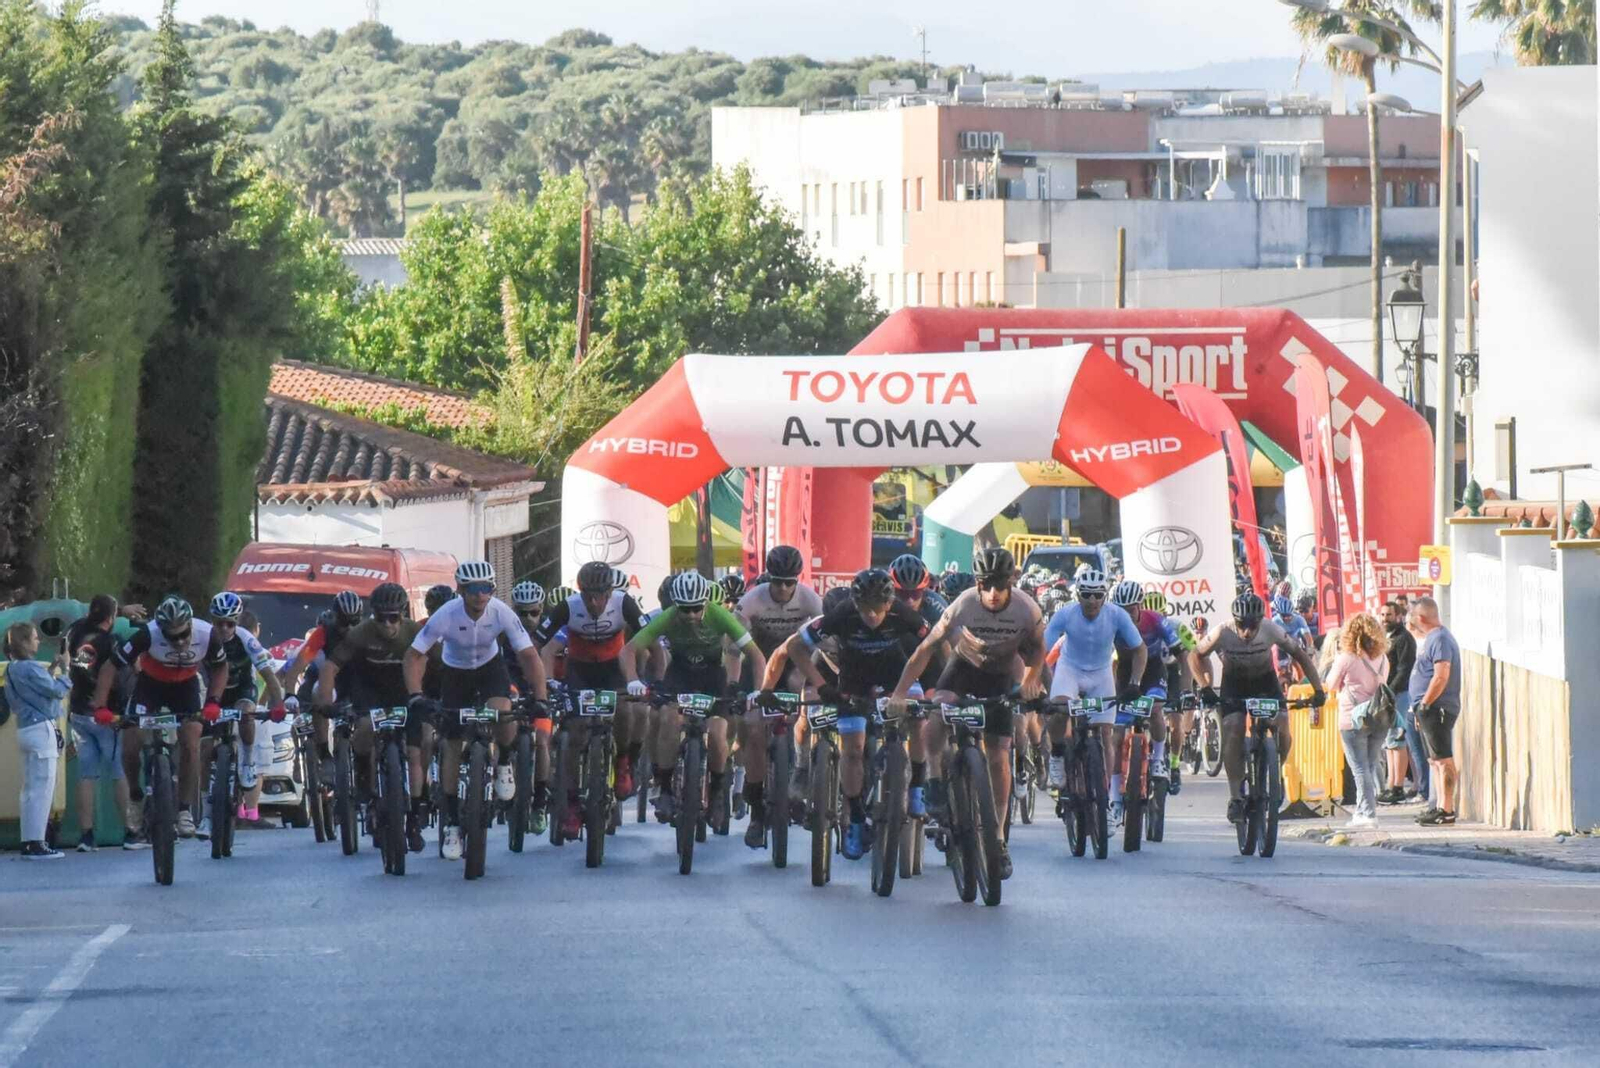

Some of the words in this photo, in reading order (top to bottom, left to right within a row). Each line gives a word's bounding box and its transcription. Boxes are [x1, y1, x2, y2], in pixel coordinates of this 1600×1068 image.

[783, 370, 978, 405] TOYOTA
[782, 416, 821, 447] A.
[826, 418, 982, 449] TOMAX
[588, 437, 699, 459] HYBRID
[1070, 436, 1182, 463] HYBRID
[236, 562, 311, 576] home
[320, 563, 389, 581] team
